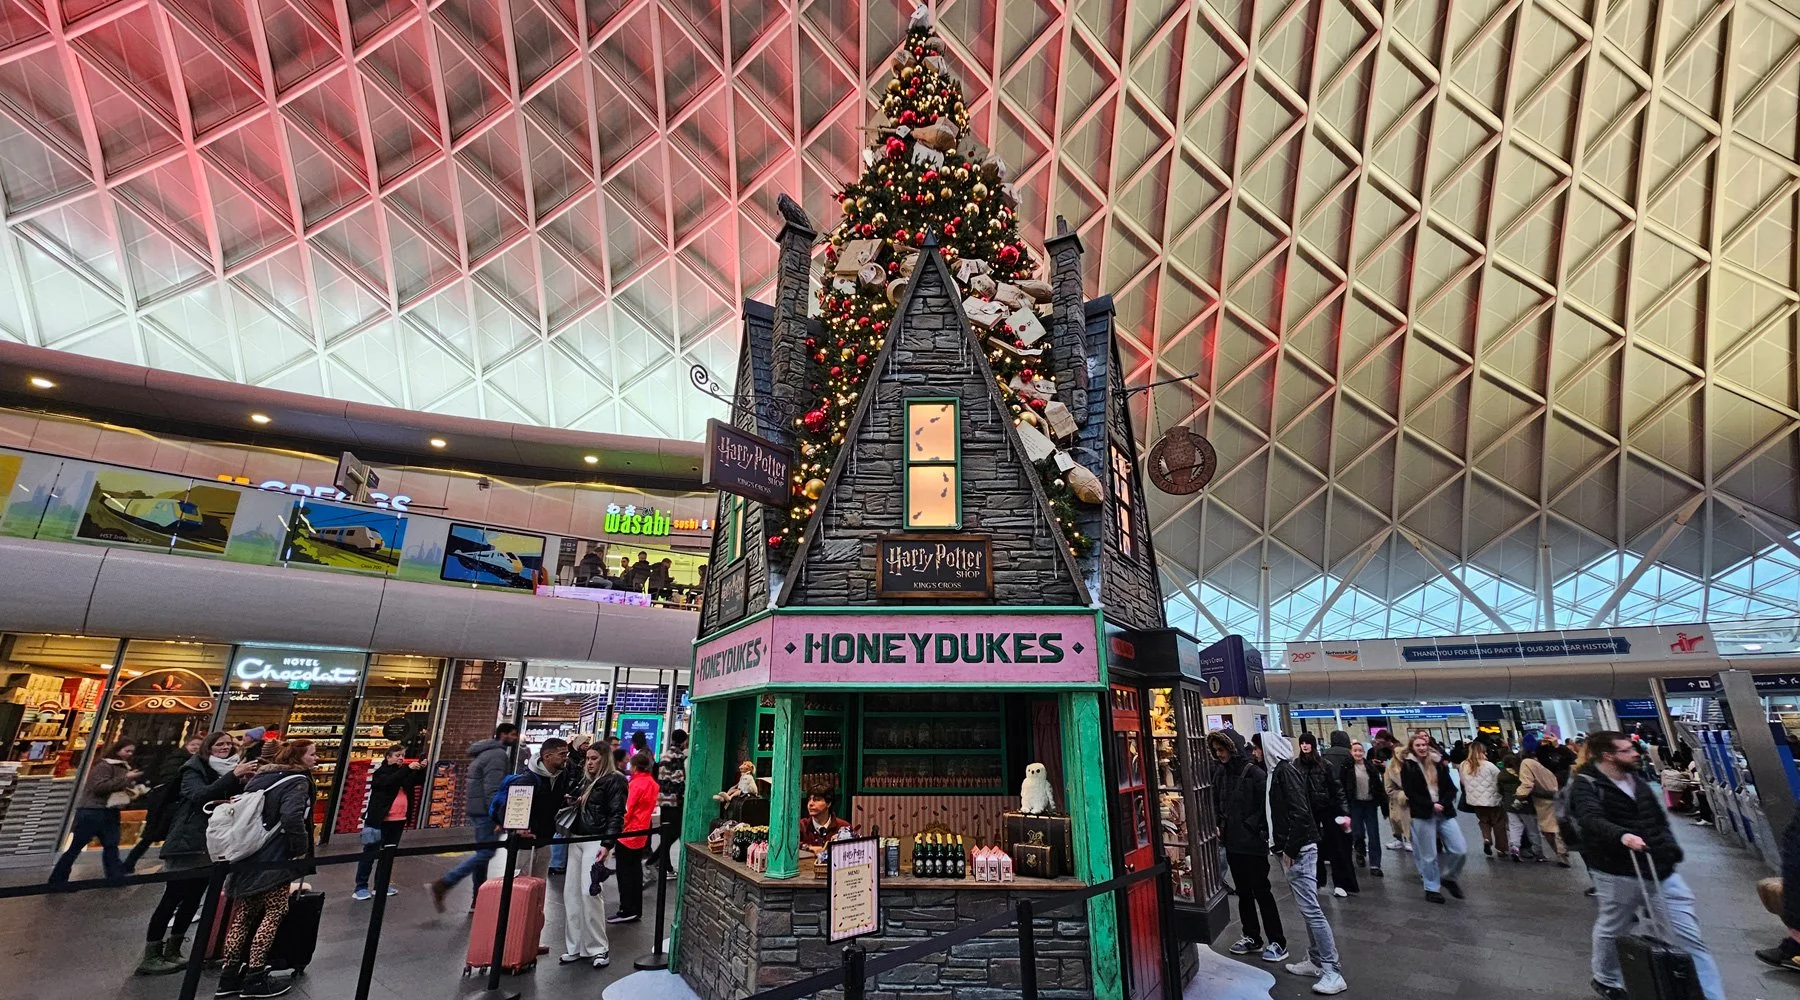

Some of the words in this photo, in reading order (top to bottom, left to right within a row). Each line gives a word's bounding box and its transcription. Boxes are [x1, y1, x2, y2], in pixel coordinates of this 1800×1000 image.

[718, 436, 753, 470] Harry
[754, 445, 787, 480] Potter
[767, 476, 785, 487] SHOP
[258, 480, 412, 511] GREGS
[604, 509, 671, 536] wasabi
[673, 518, 699, 530] sushi
[885, 546, 933, 576] Harry
[934, 543, 983, 575] Potter
[955, 570, 980, 578] SHOP
[913, 581, 937, 589] KING'S
[937, 581, 962, 589] CROSS
[803, 632, 1065, 664] HONEYDUKES
[1527, 645, 1543, 653] OUR
[1582, 642, 1619, 650] HISTORY
[282, 657, 321, 667] HOTEL
[699, 637, 762, 682] HONEYDUKES
[524, 675, 607, 695] WHSmith
